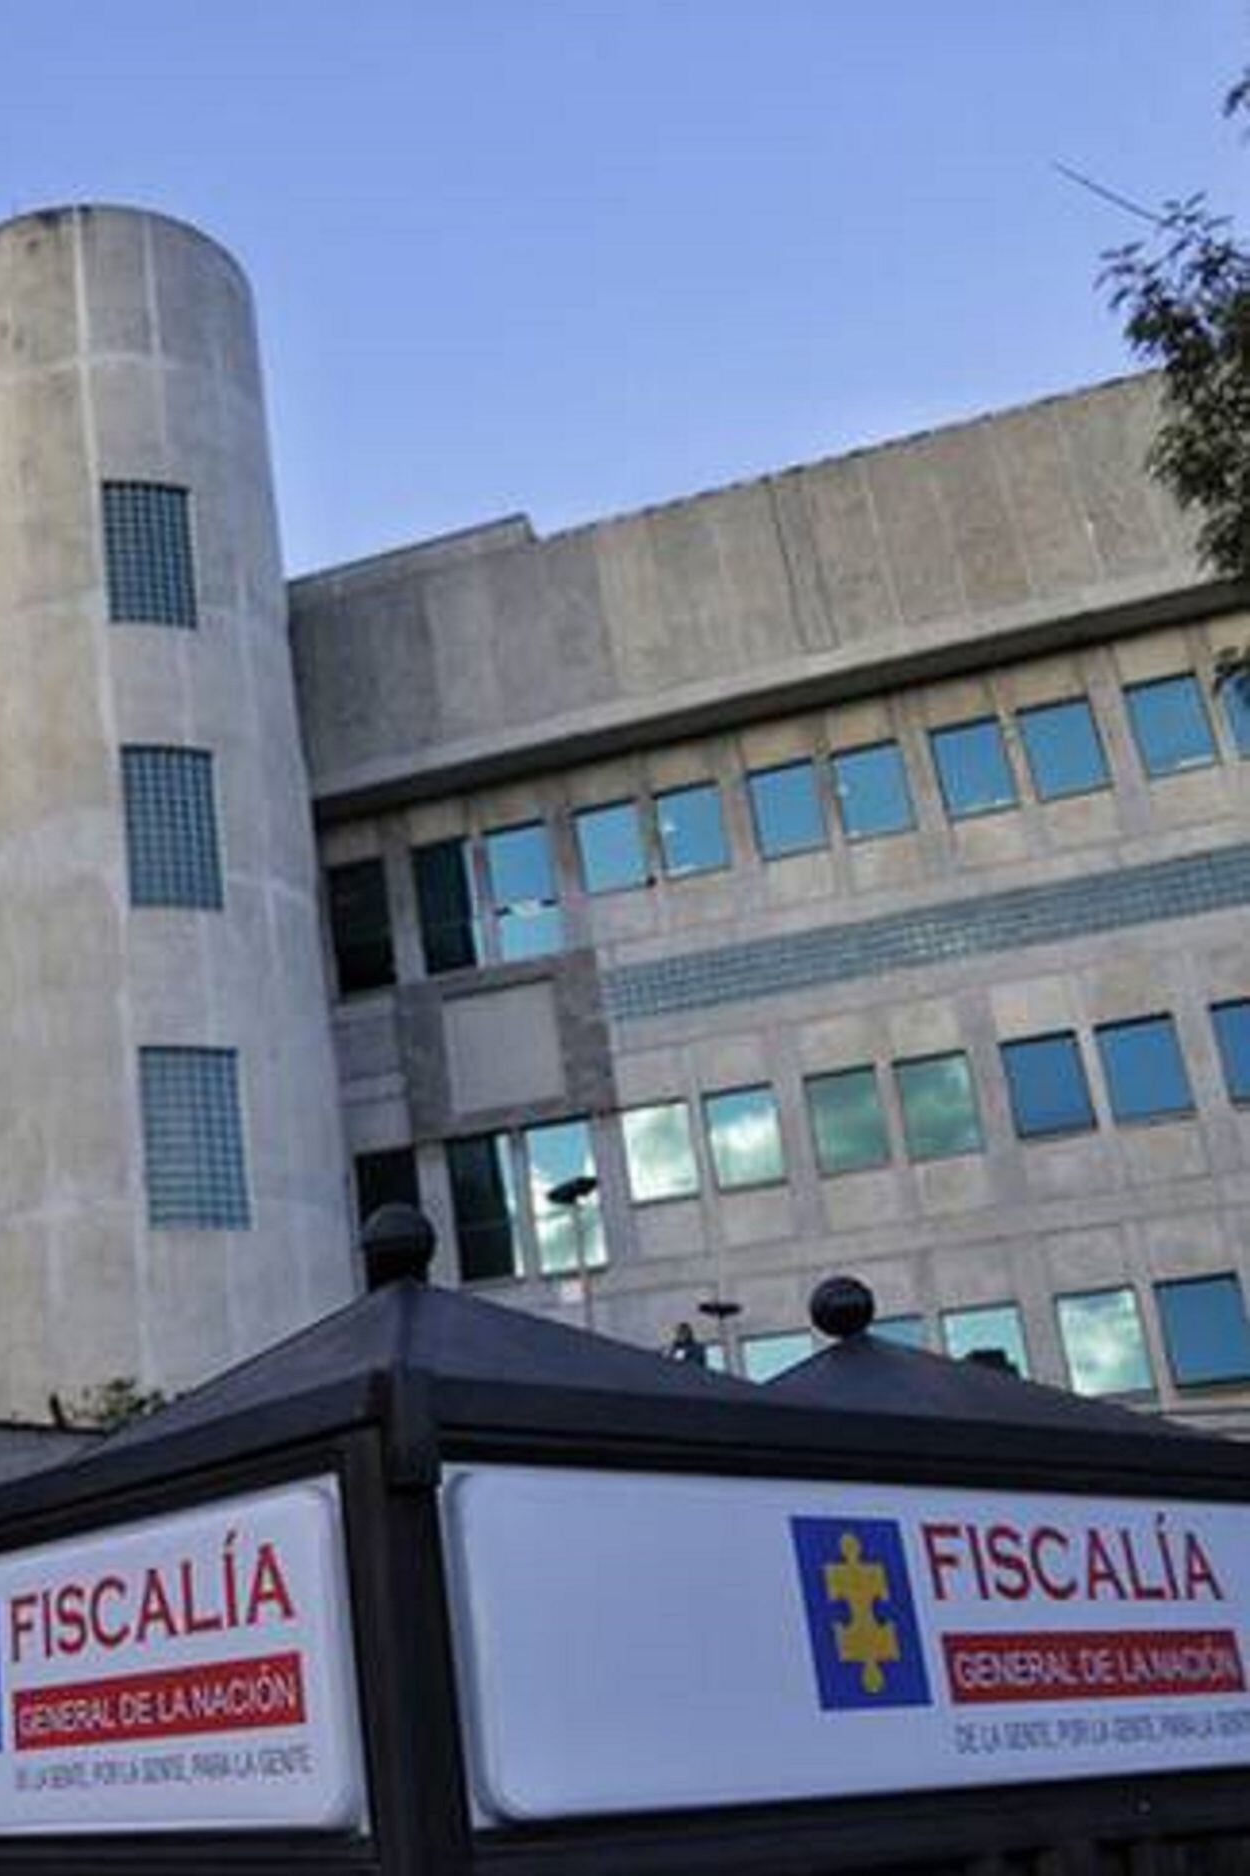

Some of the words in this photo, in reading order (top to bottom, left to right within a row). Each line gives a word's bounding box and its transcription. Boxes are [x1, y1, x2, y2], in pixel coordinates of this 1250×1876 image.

[11, 1530, 295, 1662] FISCALÍA
[921, 1512, 1225, 1601] FISCALÍA
[19, 1696, 116, 1736] GENERAL
[118, 1691, 155, 1726] DE
[157, 1686, 192, 1723] LA
[191, 1663, 297, 1717] NACIÓN
[953, 1650, 1078, 1689] GENERAL
[1079, 1649, 1115, 1684] DE
[1117, 1648, 1150, 1682] LA
